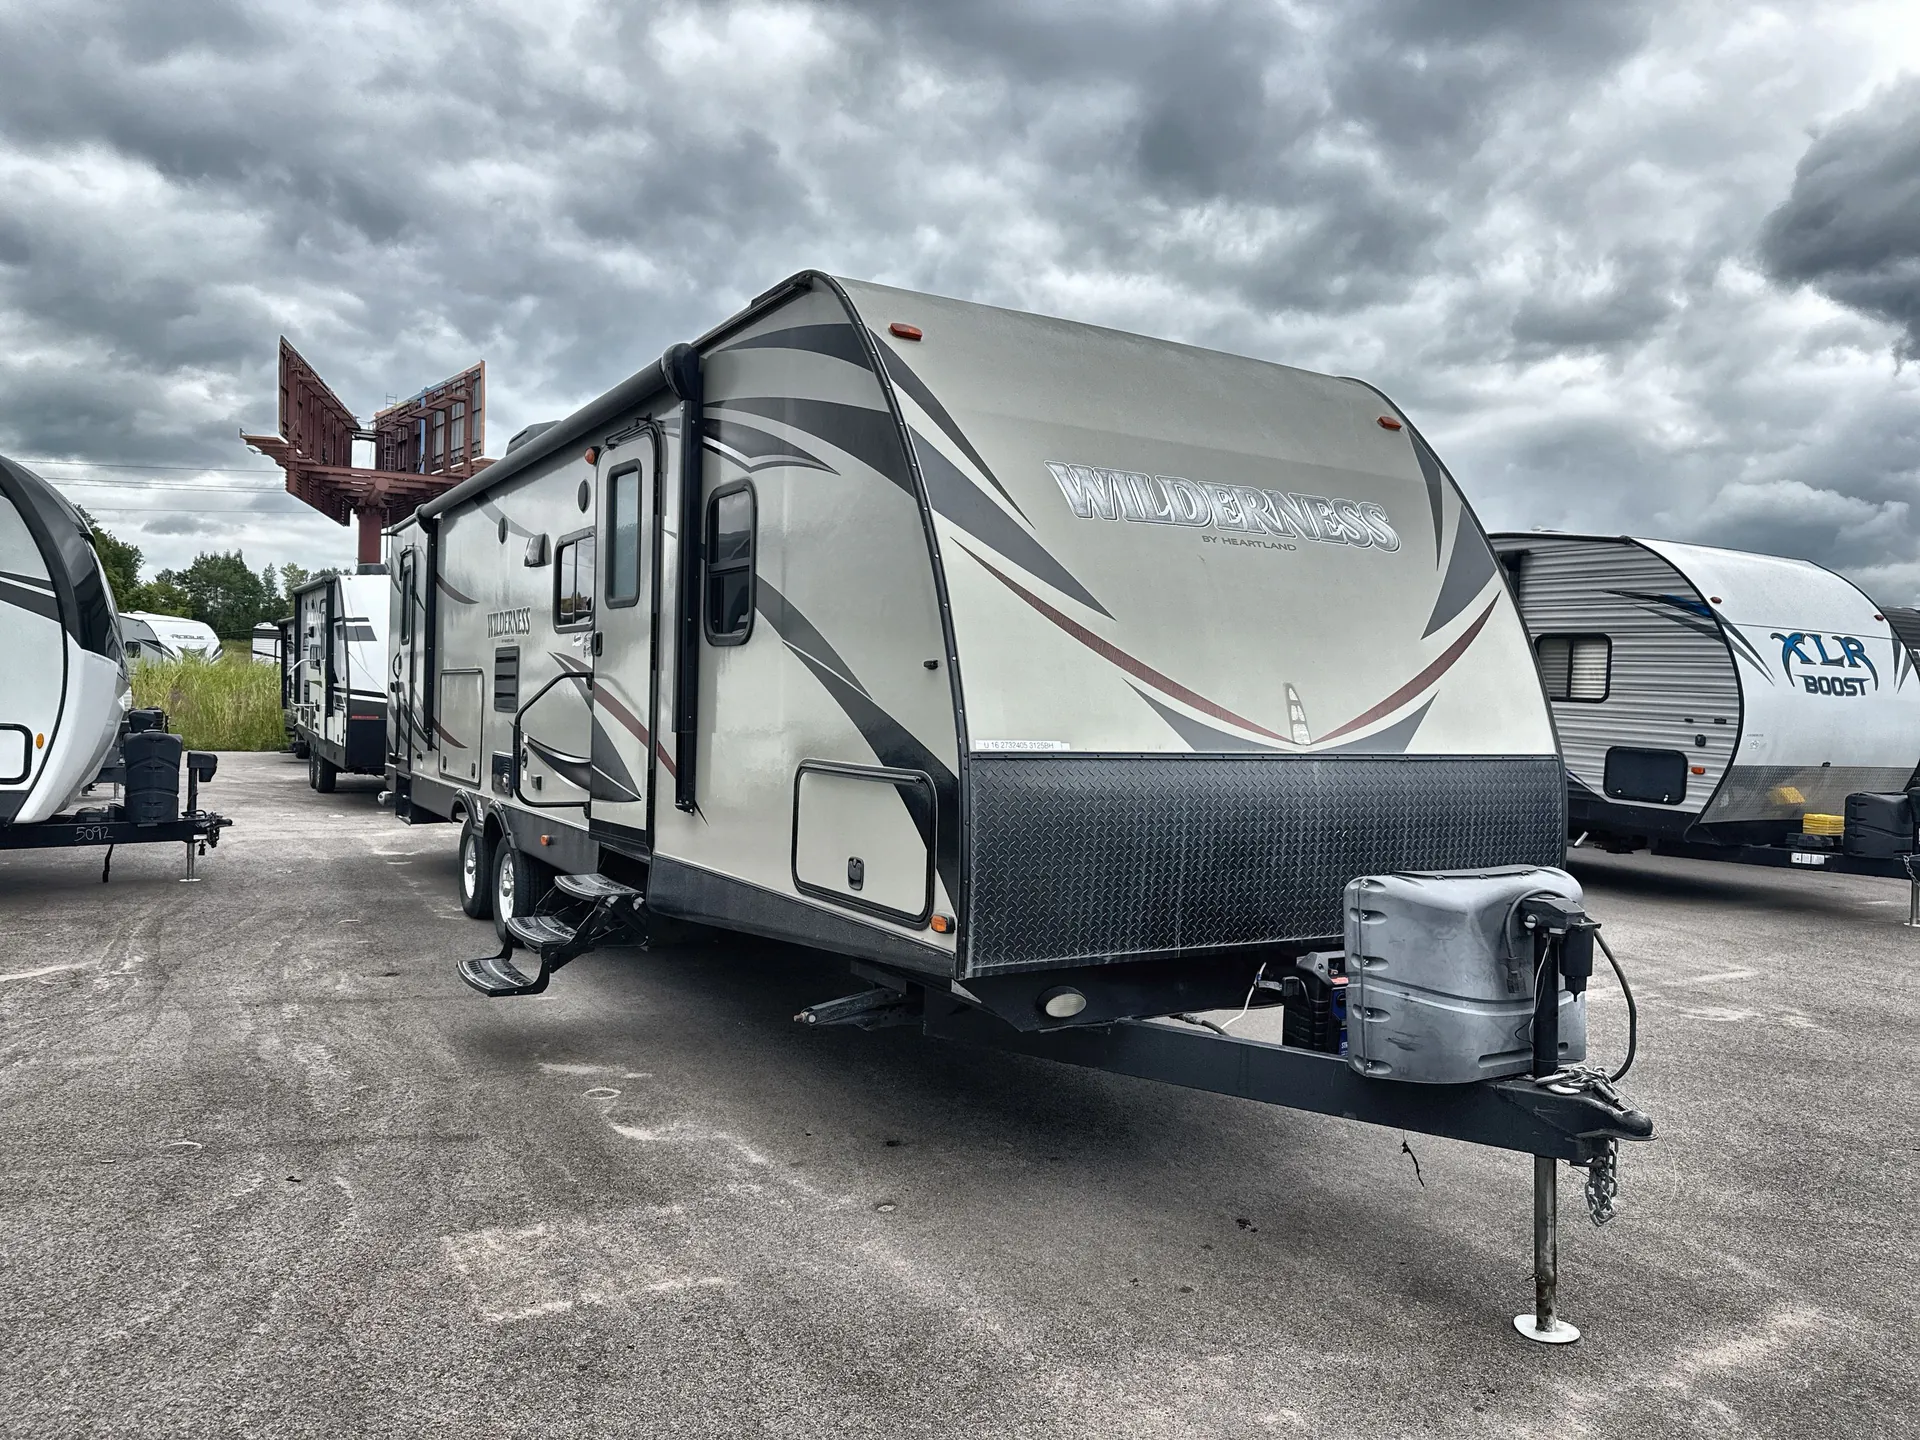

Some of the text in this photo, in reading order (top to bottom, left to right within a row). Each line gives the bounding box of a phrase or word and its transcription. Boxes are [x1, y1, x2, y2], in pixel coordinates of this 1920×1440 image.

[1044, 460, 1401, 553] WILDERNESS
[1202, 535, 1297, 551] BY HEARTLAND
[487, 606, 531, 639] WILDERNESS
[1770, 632, 1879, 691] XLR
[1794, 674, 1871, 696] BOOST
[991, 741, 1000, 749] 16
[74, 826, 114, 841] 5092
